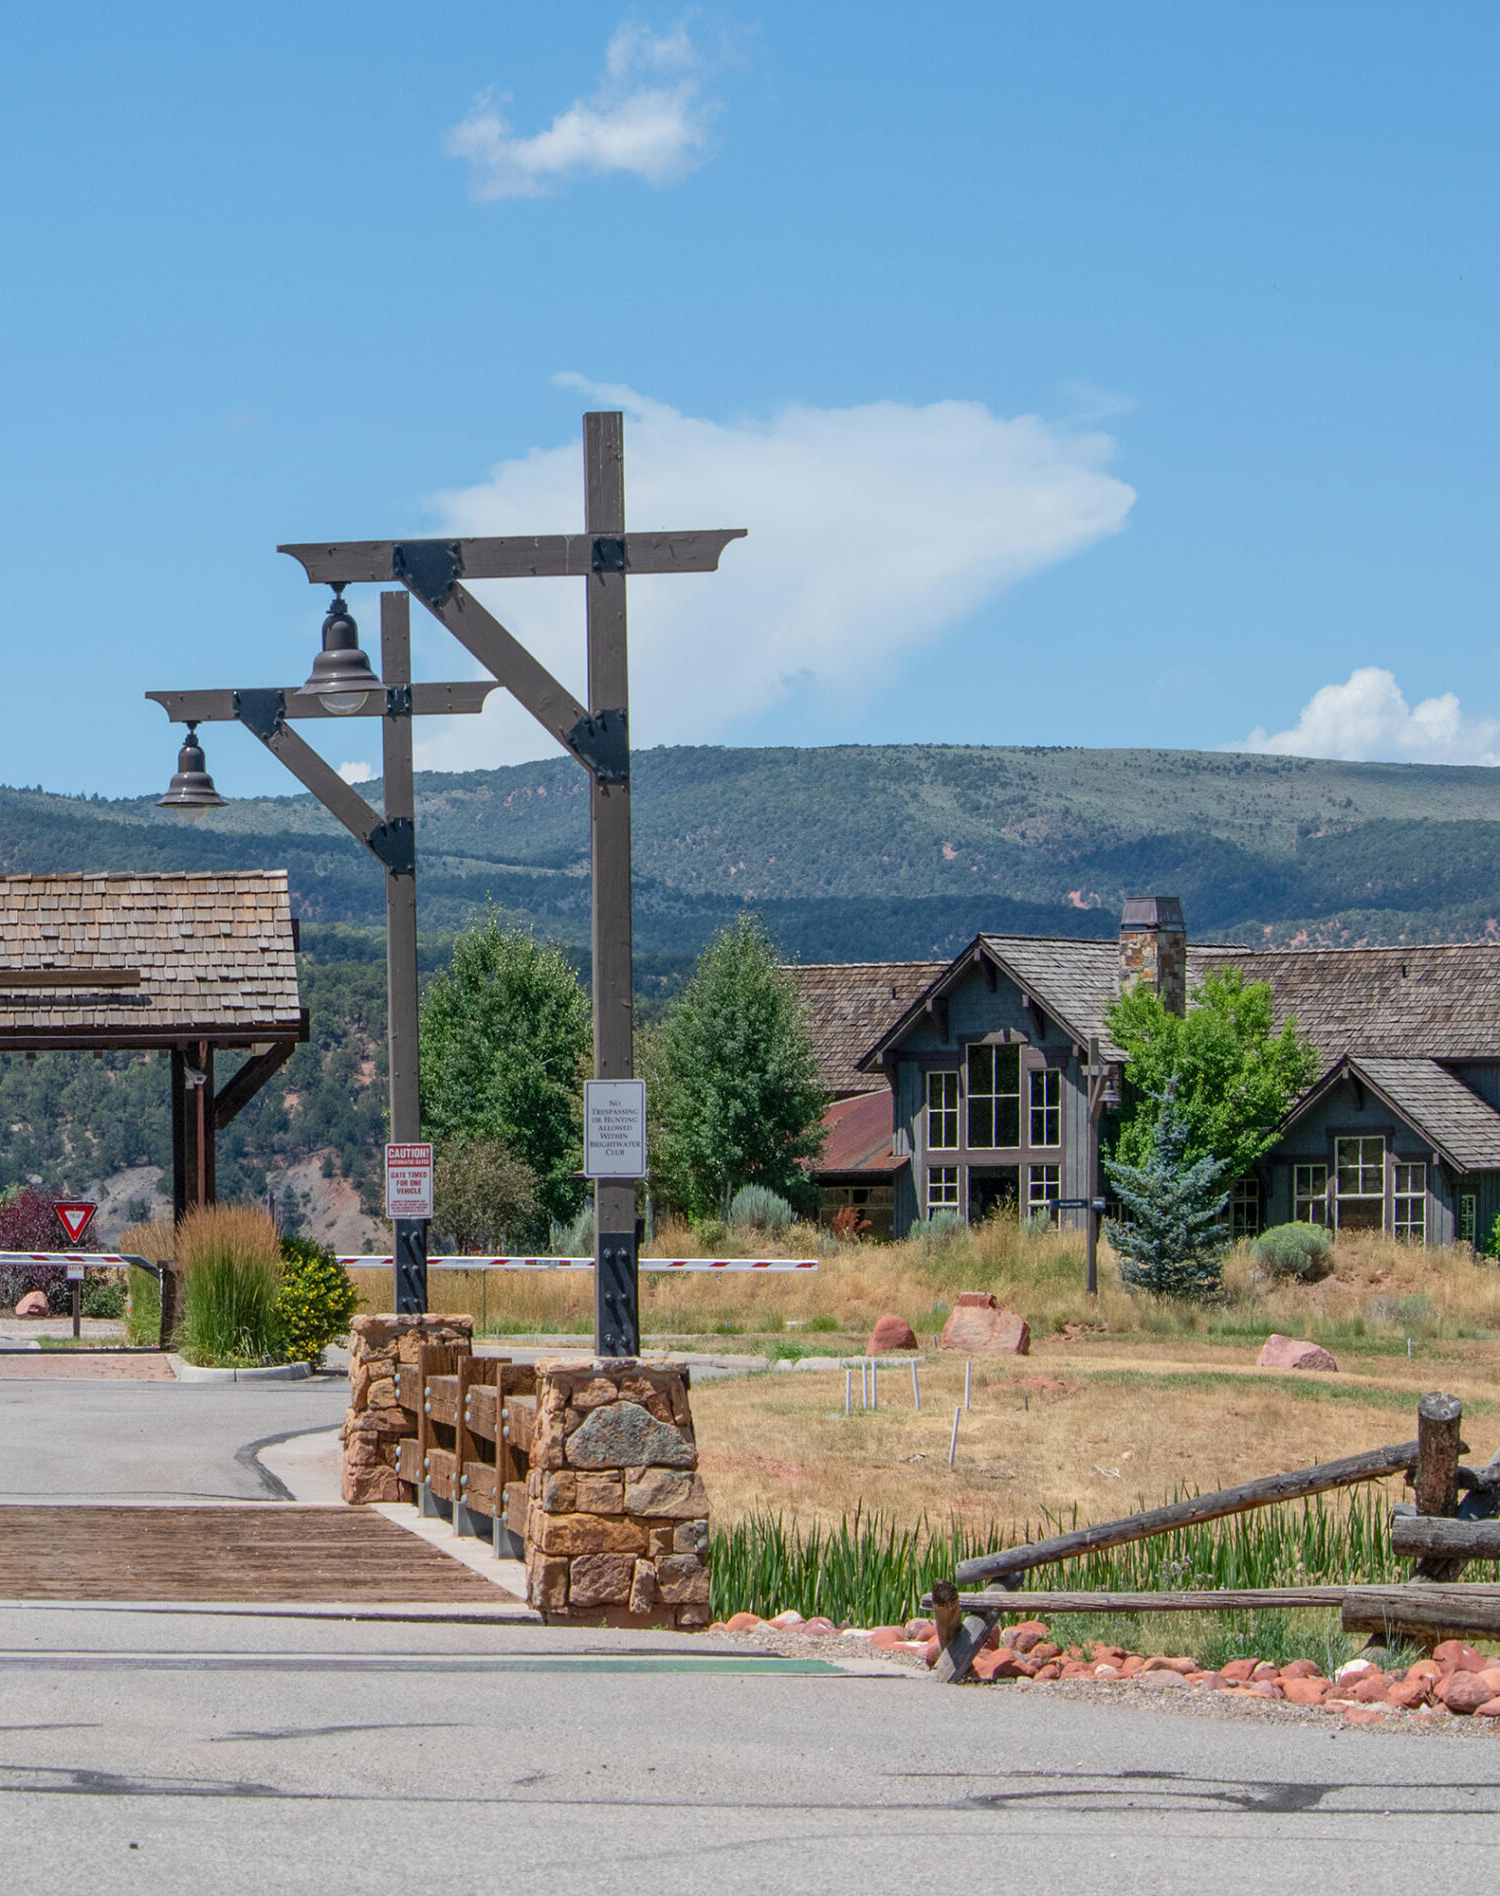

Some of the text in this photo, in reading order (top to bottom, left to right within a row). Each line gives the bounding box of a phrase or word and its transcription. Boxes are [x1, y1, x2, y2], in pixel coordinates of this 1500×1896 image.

[600, 1132, 628, 1140] WITHIN
[388, 1148, 430, 1159] CAUTION!
[605, 1148, 625, 1156] CLUB
